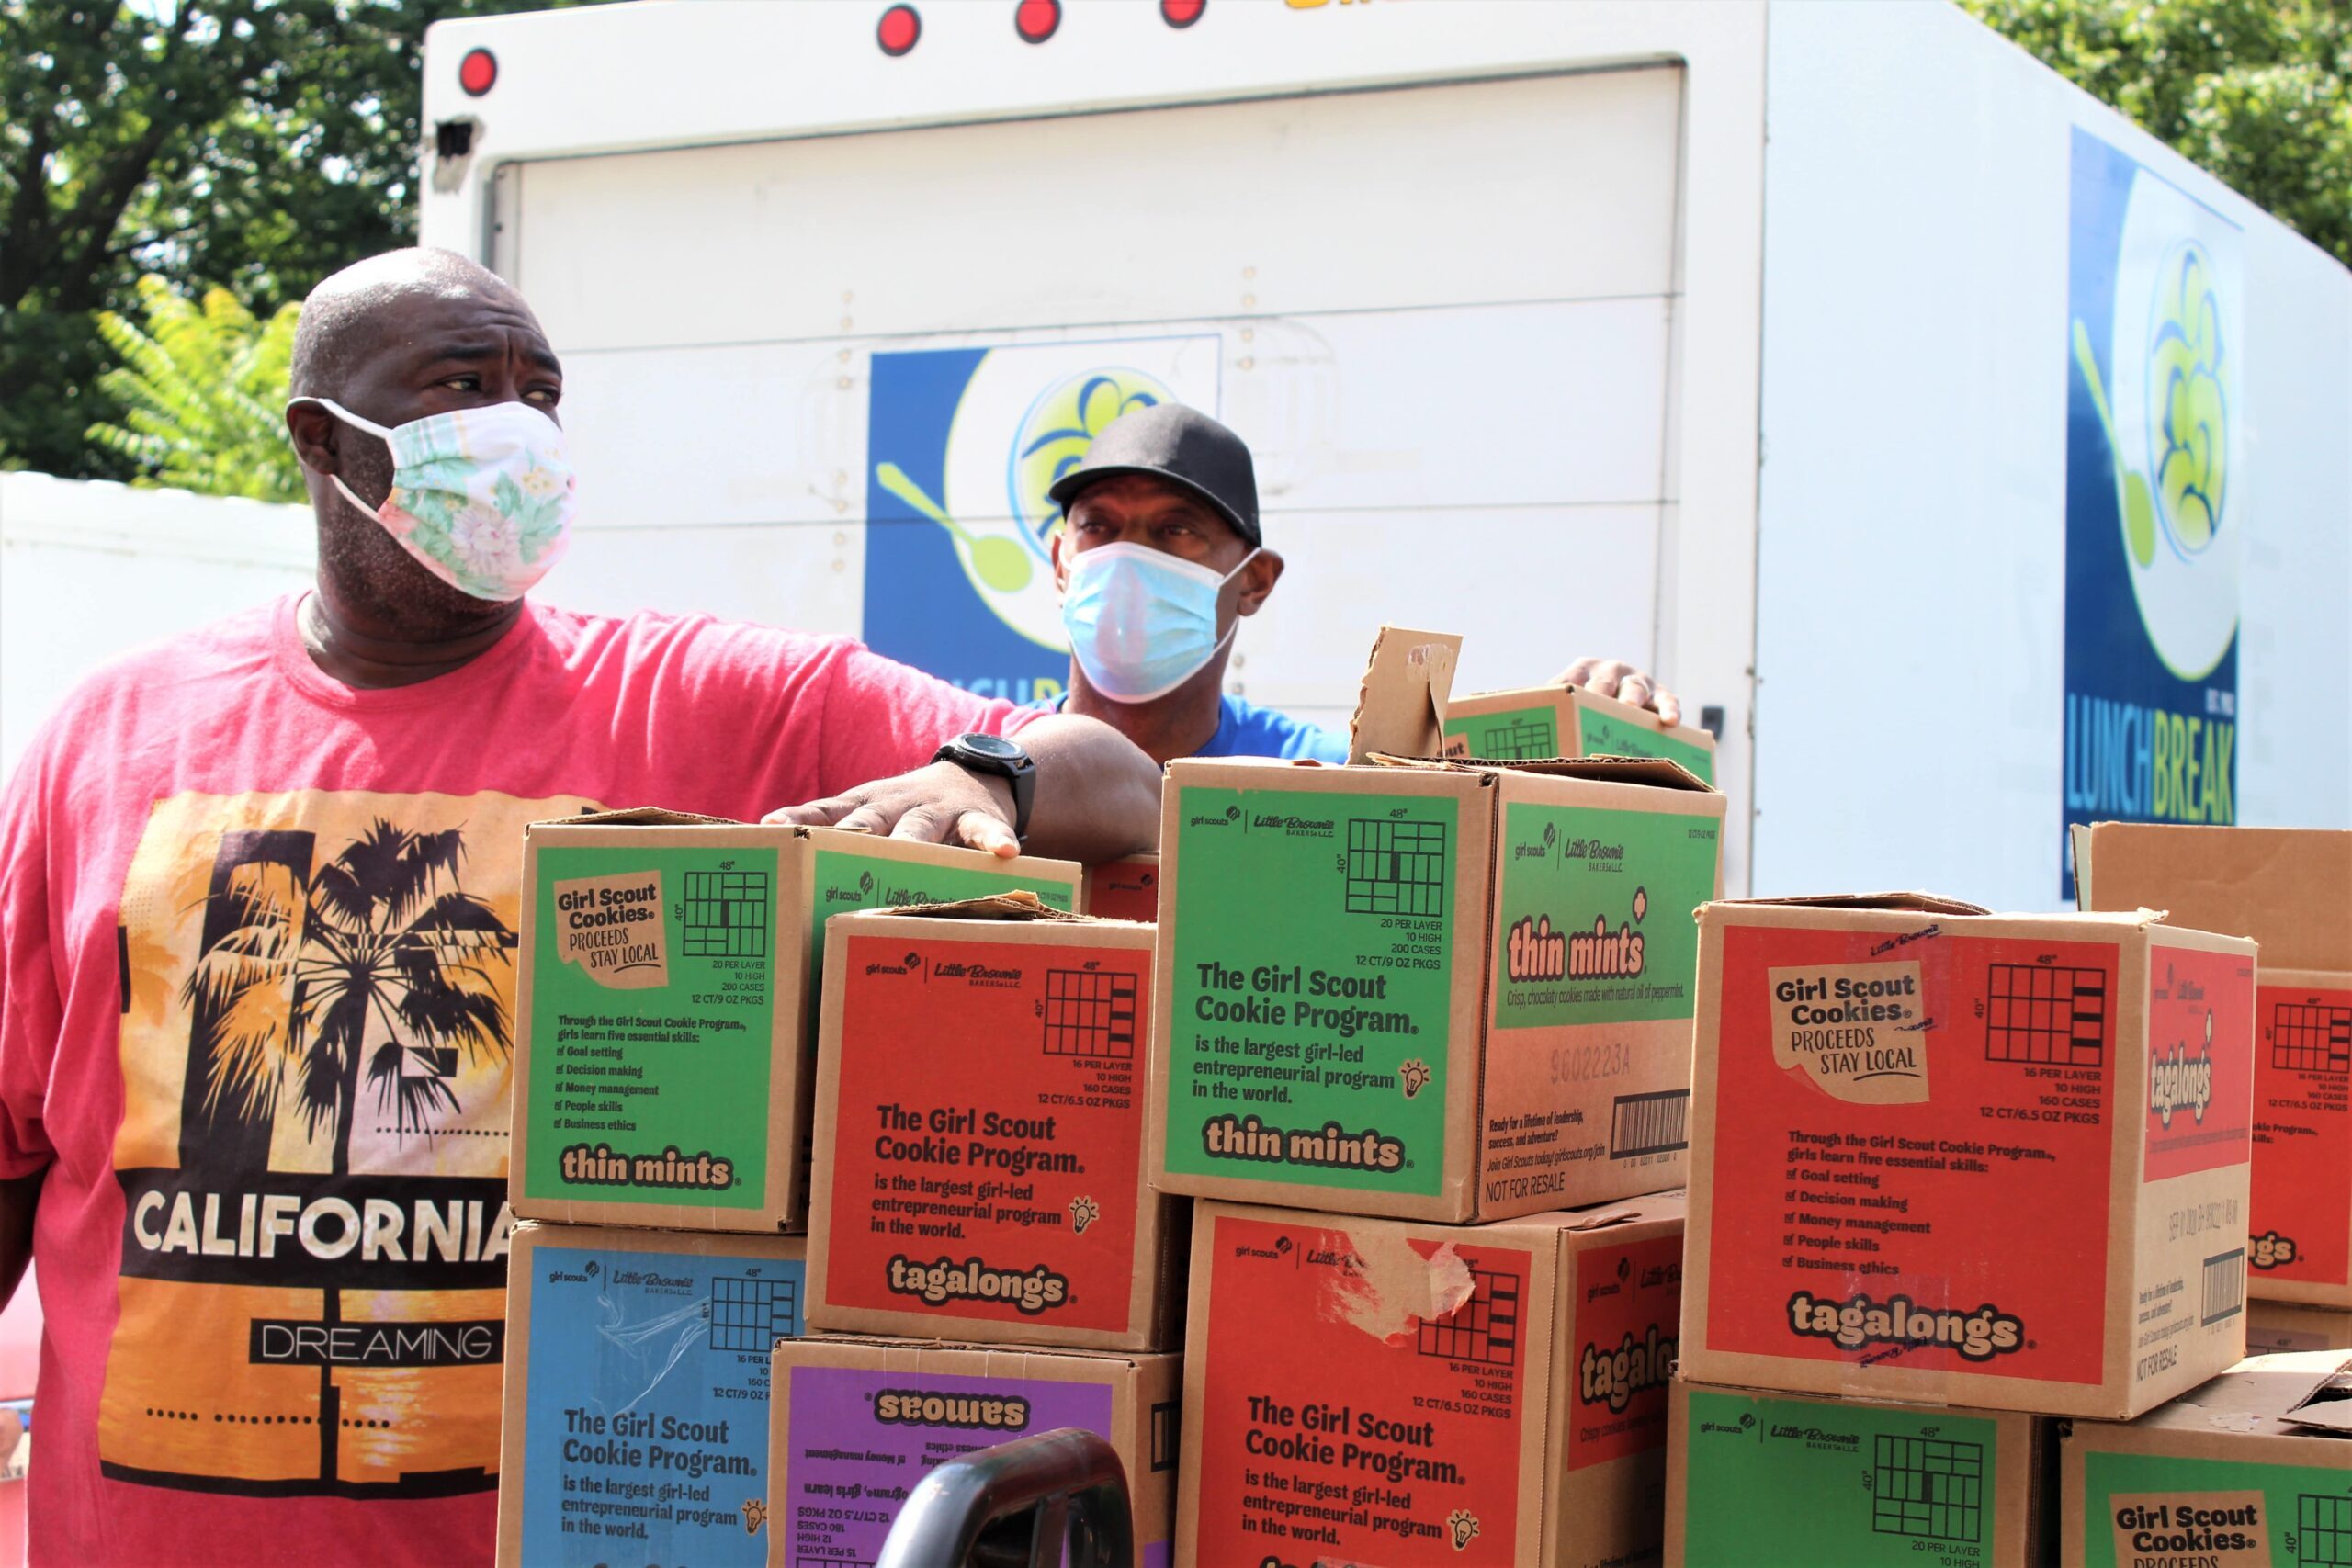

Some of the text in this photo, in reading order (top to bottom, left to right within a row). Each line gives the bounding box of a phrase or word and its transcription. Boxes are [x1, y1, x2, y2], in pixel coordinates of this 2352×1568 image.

[1191, 816, 1204, 827] girl
[1253, 814, 1283, 829] Little
[1284, 816, 1335, 830] Brownie
[1515, 838, 1624, 861] girl scouts Little Brownie
[719, 861, 735, 871] 48"
[559, 884, 656, 911] Girl Scout
[674, 904, 684, 921] 40"
[570, 928, 628, 951] PROCEEDS
[1509, 917, 1564, 978] thin
[590, 942, 659, 968] STAY LOCAL
[713, 960, 765, 969] 20 PER LAYER
[735, 972, 765, 981] 10 HIGH
[865, 963, 1022, 981] girl scouts Little Brownie
[1196, 961, 1386, 999] The Girl Scout
[722, 982, 764, 992] 200 CASES
[1507, 989, 1526, 1010] Crisp,
[1527, 987, 1558, 1009] chocolaty
[1558, 987, 1583, 1004] cookies
[1583, 986, 1600, 1002] made
[1601, 985, 1615, 1001] with
[1615, 985, 1635, 1001] natural
[1644, 983, 1652, 999] of
[1776, 975, 1915, 1002] Girl Scout
[691, 994, 764, 1005] 12 CT/9 OZ PKGS
[1195, 995, 1286, 1025] Cookie
[559, 1014, 597, 1029] Through
[598, 1016, 614, 1027] the
[616, 1016, 634, 1027] Girl
[635, 1017, 662, 1028] Scout
[664, 1017, 696, 1029] Cookie
[557, 1029, 700, 1043] girls learn five essential skills:
[1792, 1027, 1874, 1053] PROCEEDS
[567, 1045, 623, 1060] Goal setting
[1821, 1047, 1917, 1075] STAY LOCAL
[566, 1064, 643, 1079] Decision making
[565, 1082, 659, 1097] Money management
[2150, 1045, 2211, 1125] tagalongs
[564, 1100, 623, 1113] People skills
[1038, 1093, 1131, 1109] 12 CT/6.5 OZ PKGS
[564, 1118, 636, 1132] Business ethics
[877, 1103, 1056, 1141] The Girl Scout
[1489, 1117, 1509, 1134] Ready
[1509, 1116, 1519, 1130] for
[1523, 1113, 1546, 1128] lifetime
[1546, 1111, 1554, 1125] of
[1205, 1119, 1282, 1159] thin
[1515, 1132, 1527, 1146] and
[1527, 1129, 1558, 1145] adventure?
[875, 1135, 961, 1165] Cookie
[561, 1145, 629, 1182] thin
[1487, 1160, 1501, 1172] Join
[1501, 1156, 1514, 1170] Girl
[1513, 1155, 1534, 1168] Scouts
[875, 1172, 1034, 1201] is the largest girl-led
[1486, 1171, 1566, 1203] NOT FOR RESALE
[871, 1198, 1062, 1226] entrepreneurial program
[133, 1190, 511, 1262] CALIFORNIA
[871, 1216, 965, 1238] in the world.
[262, 1325, 492, 1360] DREAMING
[564, 1407, 729, 1444] The Girl Scout
[1248, 1396, 1434, 1448] The Girl Scout
[1770, 1424, 1860, 1444] Little Brownie
[563, 1438, 642, 1467] Cookie
[1246, 1429, 1335, 1465] Cookie
[797, 1506, 890, 1523] 12 CT/7.5 OZ PKGS
[2117, 1505, 2257, 1529] Girl Scout
[797, 1520, 845, 1533] 180 CASES
[797, 1532, 832, 1543] 12 HIGH
[797, 1544, 856, 1558] 15 PER LAYER
